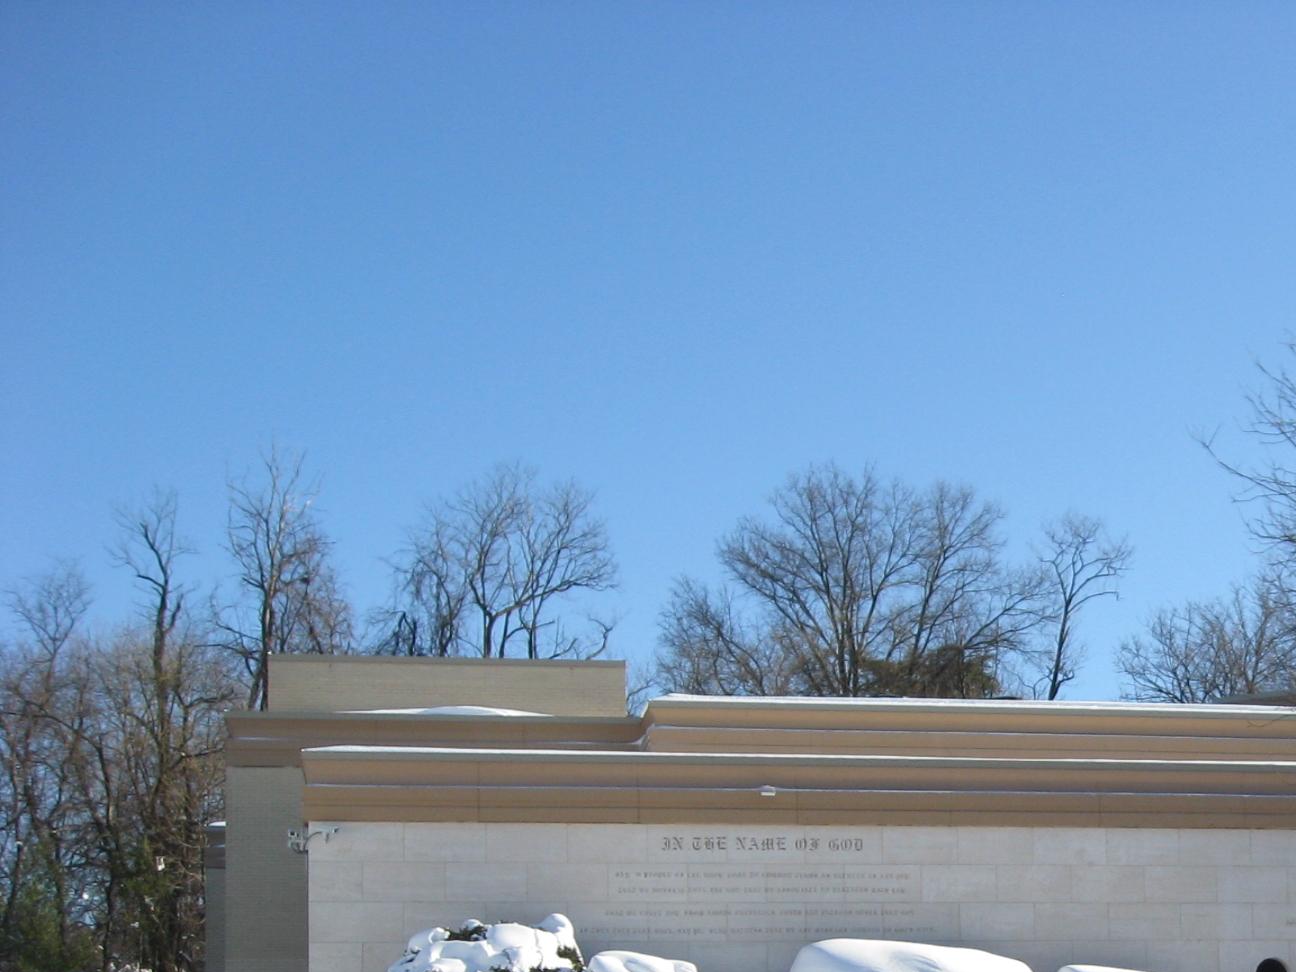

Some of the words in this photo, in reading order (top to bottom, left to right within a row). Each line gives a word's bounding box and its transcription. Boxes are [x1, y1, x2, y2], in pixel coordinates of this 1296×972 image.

[662, 836, 684, 851] IN
[692, 836, 727, 851] THE
[736, 836, 787, 851] NAME
[795, 837, 820, 851] OF
[828, 838, 863, 852] GOD
